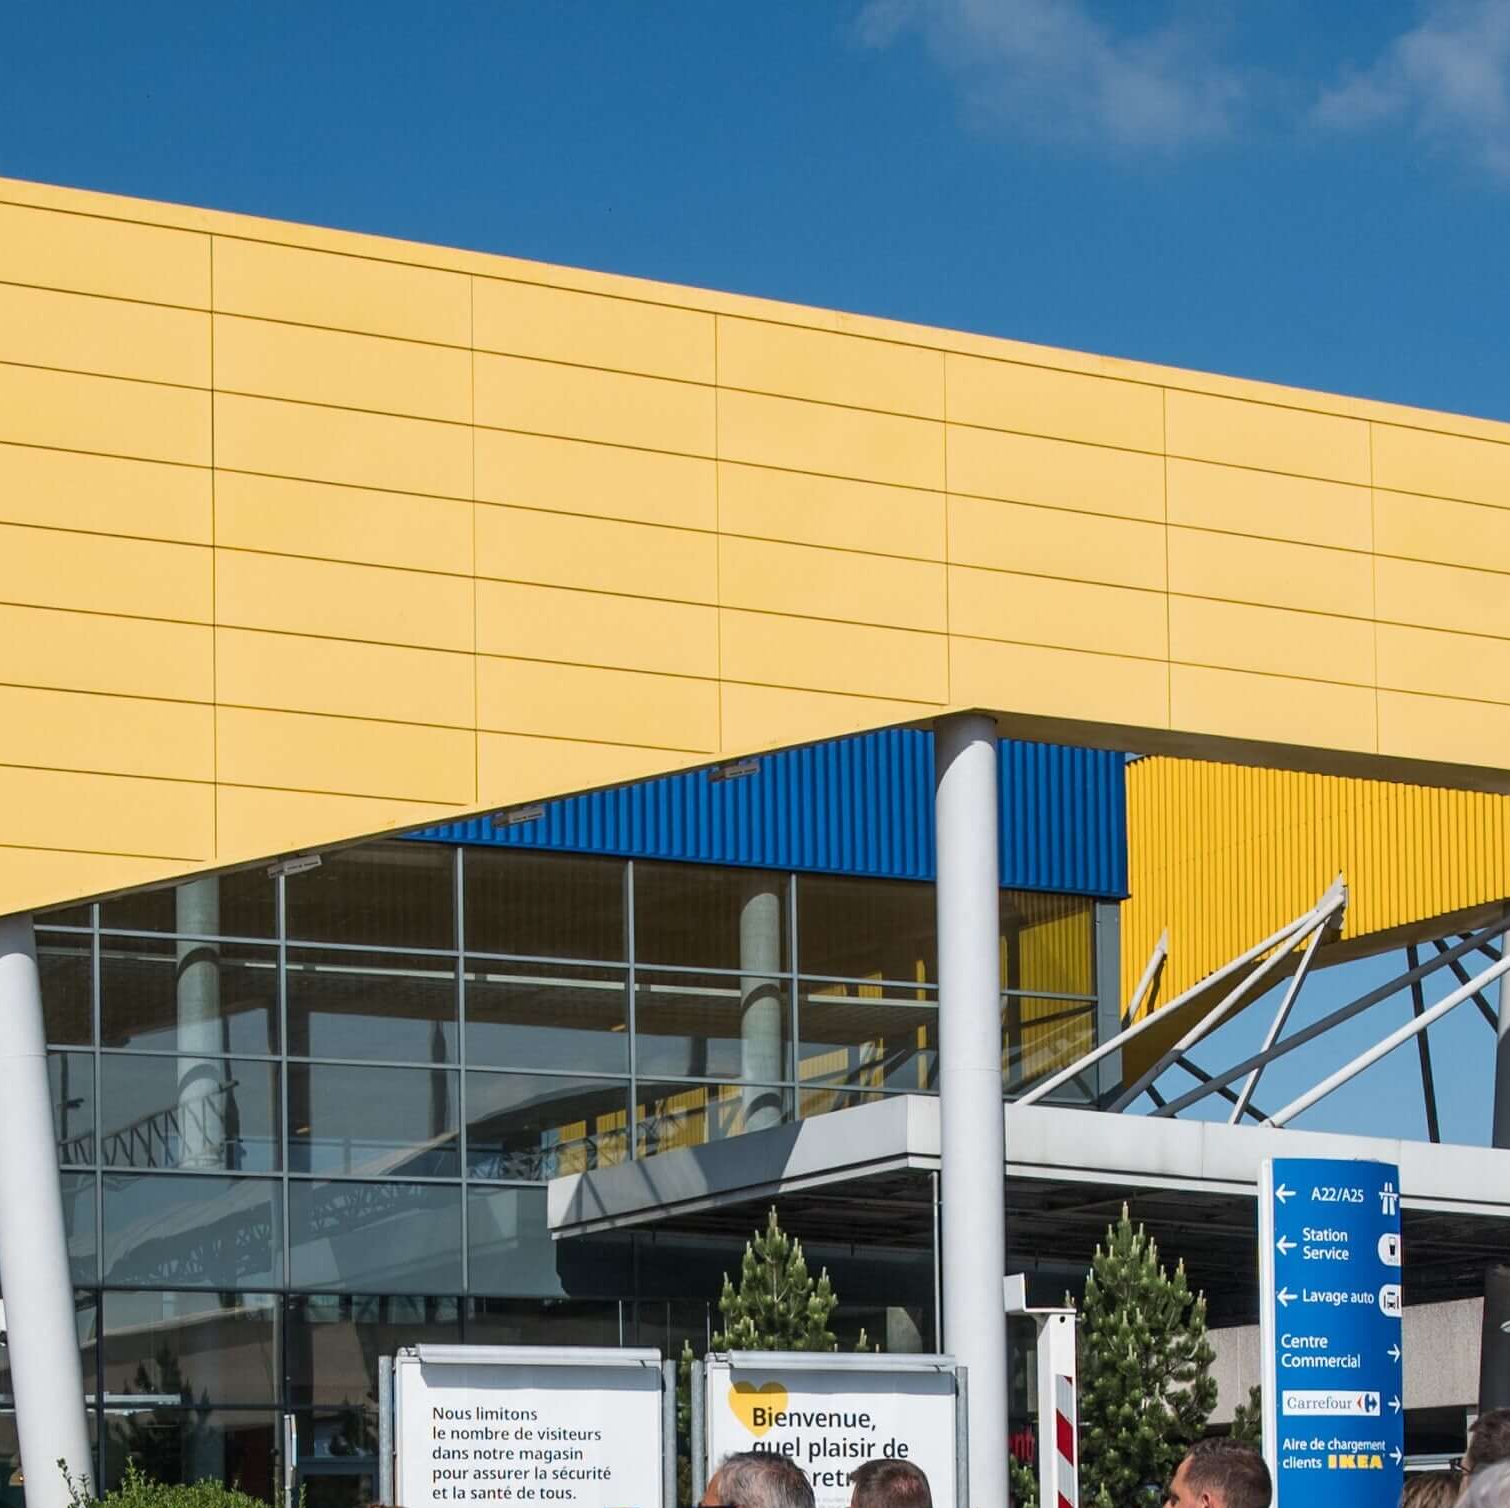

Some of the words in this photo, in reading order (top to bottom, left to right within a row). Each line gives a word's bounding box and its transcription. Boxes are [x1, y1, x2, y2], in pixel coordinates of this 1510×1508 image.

[1311, 1186, 1364, 1203] A22/A25
[1302, 1226, 1348, 1242] Station
[1302, 1246, 1349, 1261] Service
[1302, 1288, 1348, 1306] Lavage
[1350, 1292, 1374, 1305] auto
[1281, 1333, 1328, 1349] Centre
[1281, 1353, 1361, 1369] Commercial
[1287, 1396, 1352, 1410] Carrefour
[432, 1406, 472, 1421] Nous
[476, 1406, 538, 1421] limitons
[752, 1406, 876, 1431] Bienvenue,
[433, 1426, 446, 1440] le
[451, 1426, 509, 1440] nombre
[514, 1426, 533, 1440] de
[537, 1427, 602, 1441] visiteurs
[808, 1436, 876, 1463] plaisir
[883, 1437, 909, 1458] de
[1282, 1438, 1307, 1451] Aire
[1309, 1438, 1325, 1451] de
[1327, 1439, 1386, 1453] chargement
[432, 1446, 469, 1460] dans
[473, 1447, 514, 1460] notre
[519, 1447, 583, 1463] magasin
[1282, 1457, 1322, 1469] clients
[1328, 1455, 1383, 1469] IKEA
[432, 1468, 469, 1483] pour
[473, 1468, 530, 1480] assurer
[534, 1466, 548, 1480] la
[552, 1465, 612, 1480] sécurité
[432, 1487, 447, 1499] et
[453, 1486, 466, 1499] la
[470, 1485, 512, 1499] santé
[516, 1486, 535, 1499] de
[539, 1487, 577, 1499] tous.
